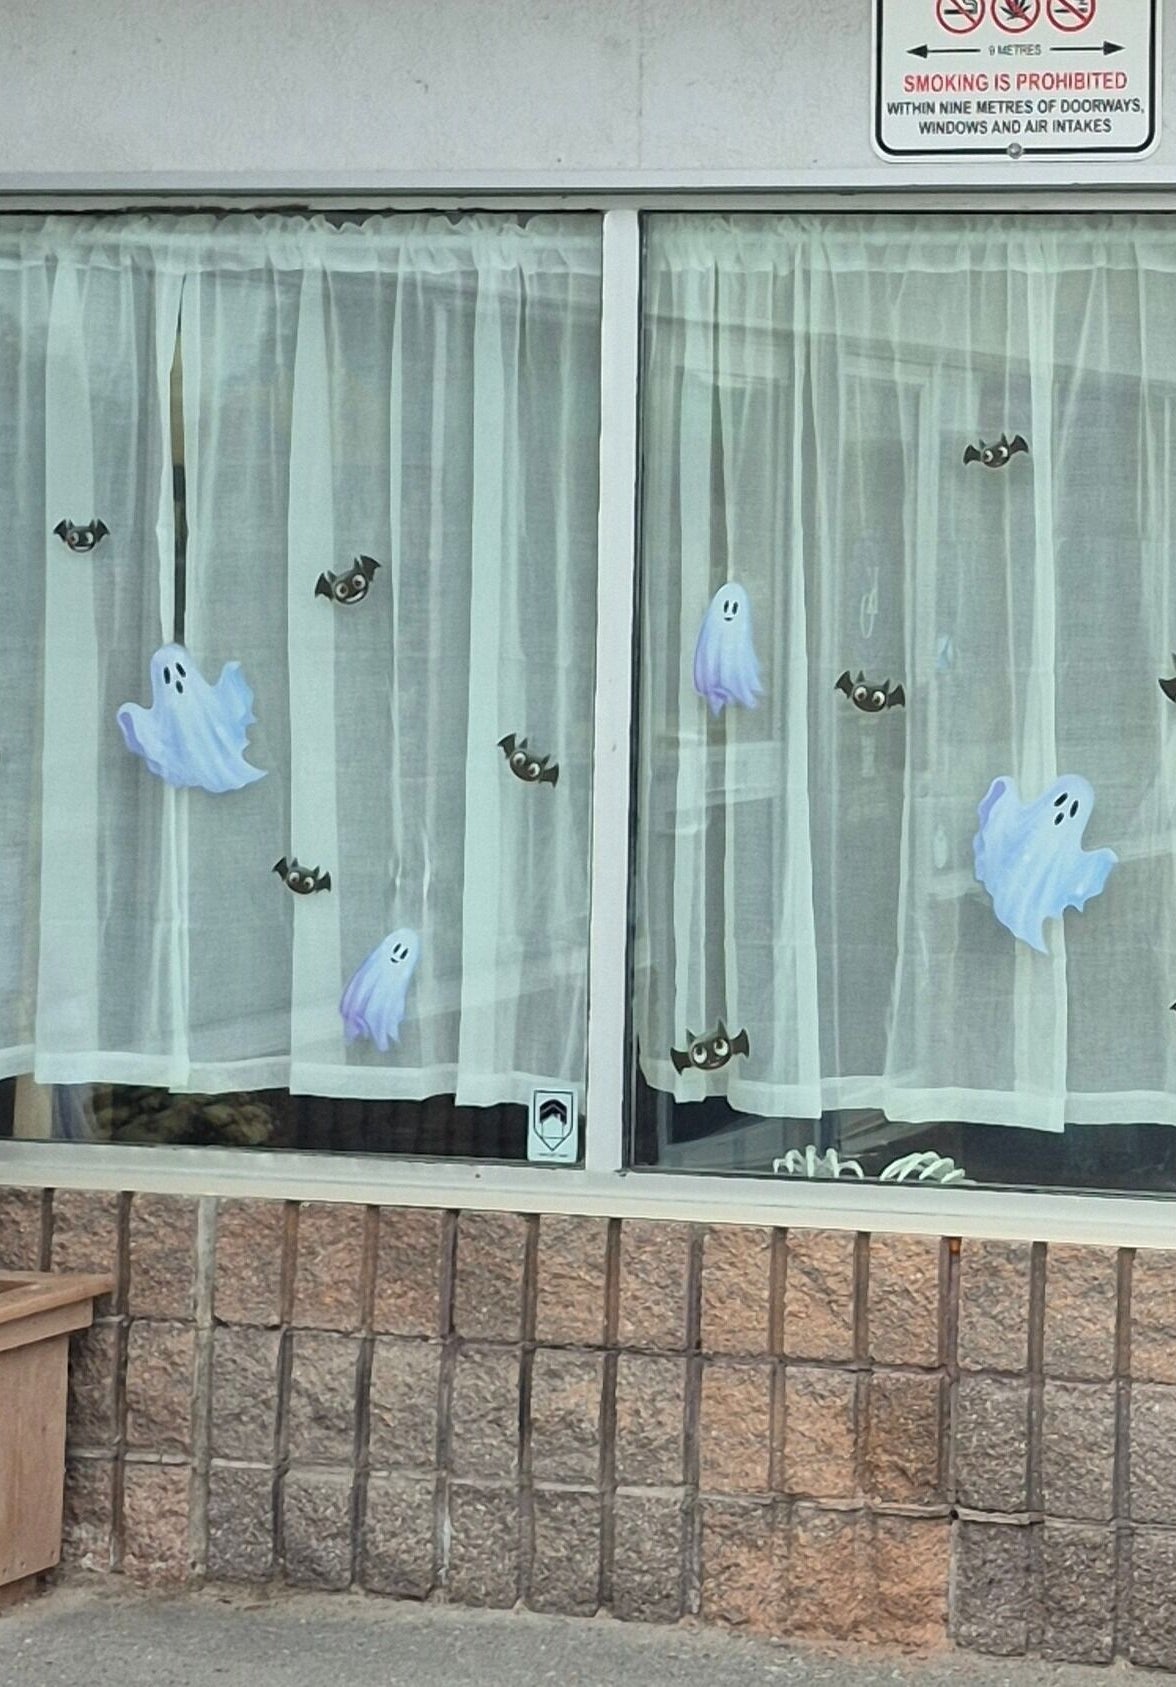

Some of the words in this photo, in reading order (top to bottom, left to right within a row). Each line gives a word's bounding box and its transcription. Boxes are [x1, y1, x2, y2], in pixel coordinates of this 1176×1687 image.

[988, 45, 995, 56] 9
[997, 44, 1041, 56] METRES
[904, 74, 989, 92] SMOKING
[995, 74, 1011, 91] IS
[1016, 72, 1128, 90] PROHIBITED
[887, 101, 935, 115] WITHIN
[940, 101, 972, 114] NINE
[976, 99, 1033, 114] METRES
[1037, 99, 1057, 114] OF
[1060, 98, 1145, 114] DOORWAYS,
[919, 120, 988, 134] WINDOWS
[991, 120, 1021, 134] AND
[1024, 119, 1048, 133] AIR
[1052, 118, 1112, 133] INTAKES
